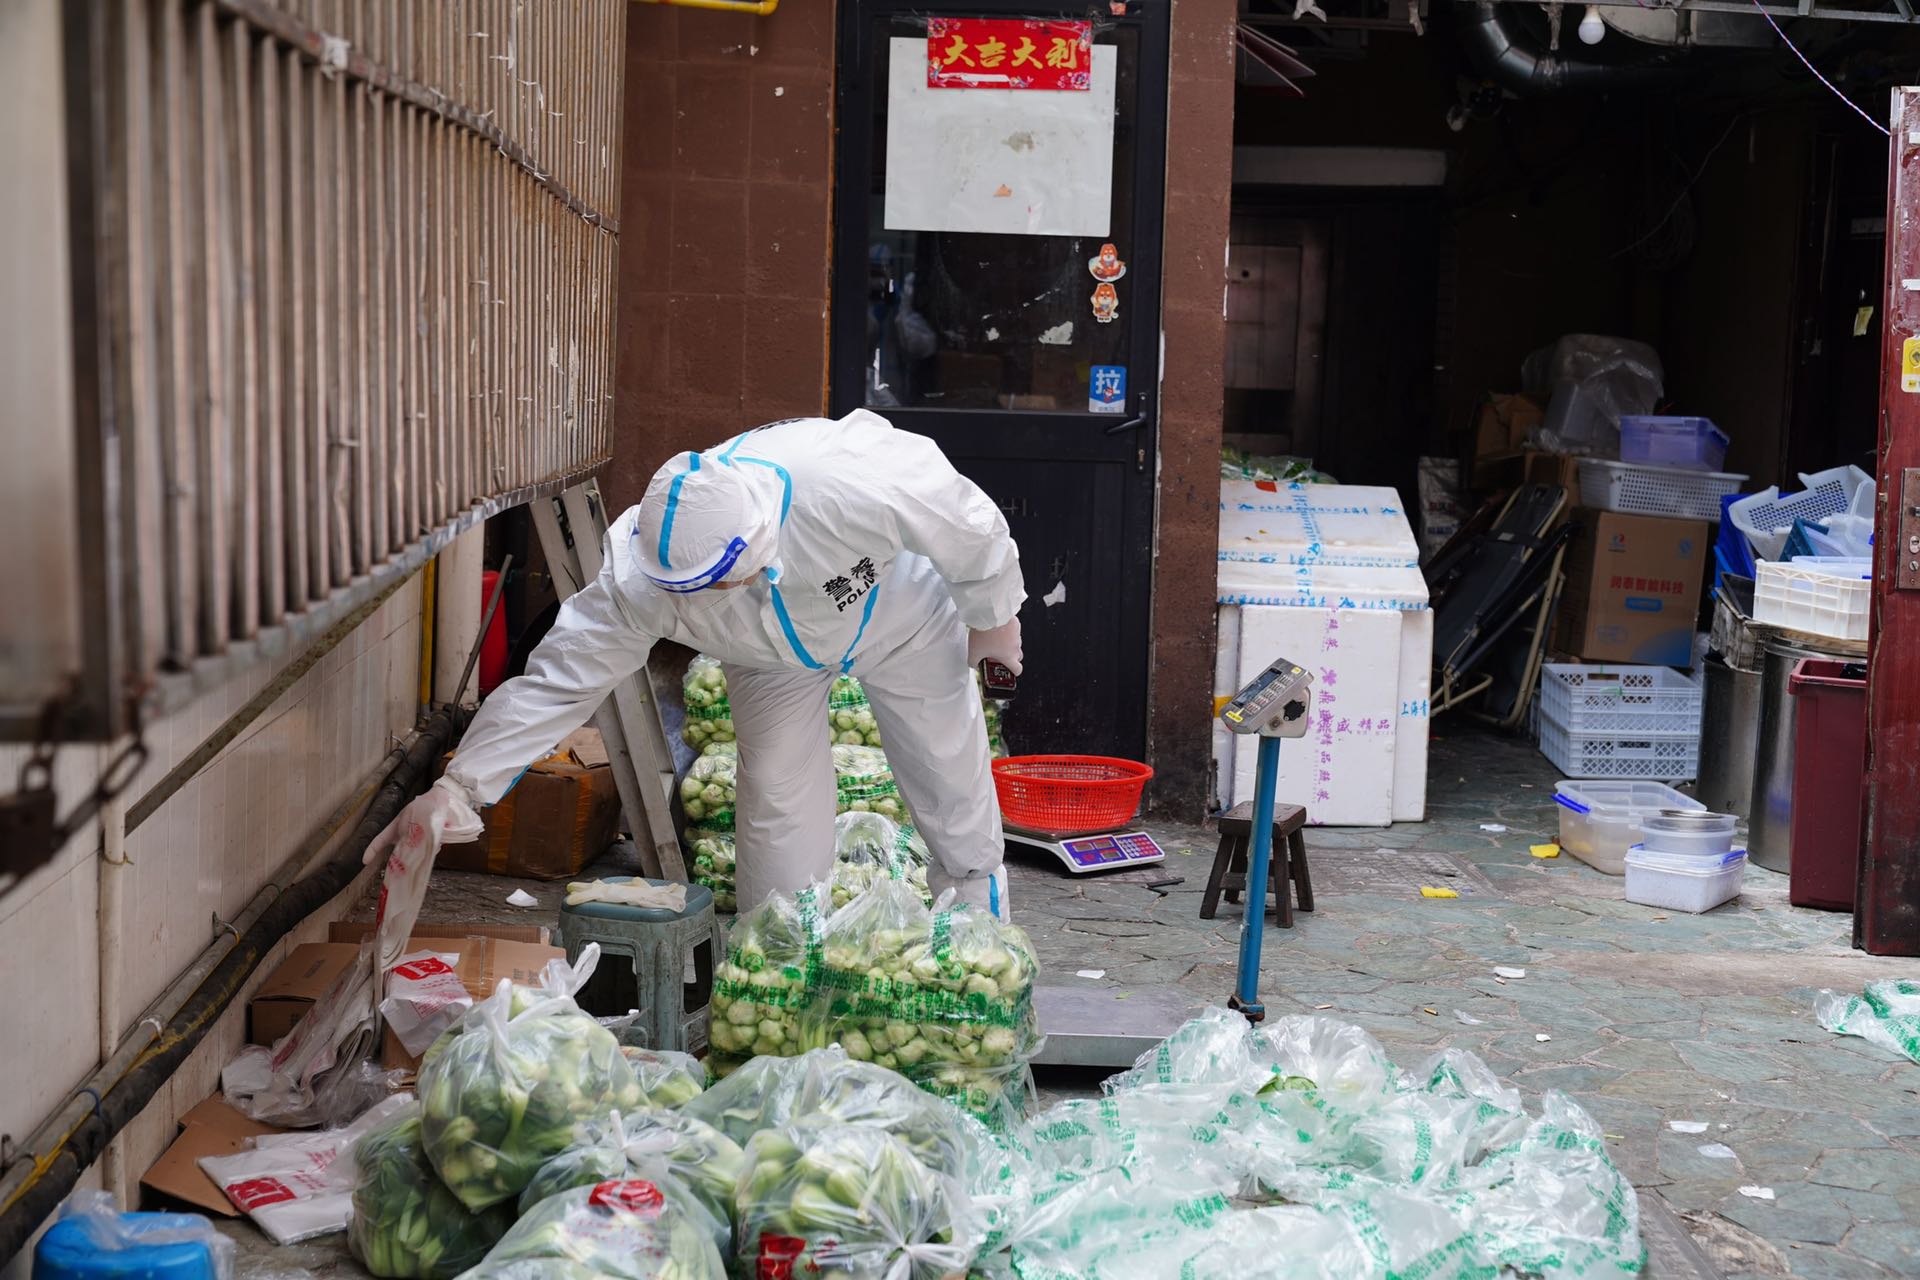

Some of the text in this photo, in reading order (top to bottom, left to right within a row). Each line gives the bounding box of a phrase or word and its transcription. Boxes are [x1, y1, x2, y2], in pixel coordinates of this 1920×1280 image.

[943, 35, 1078, 70] 大吉大利
[822, 556, 876, 601] 警察
